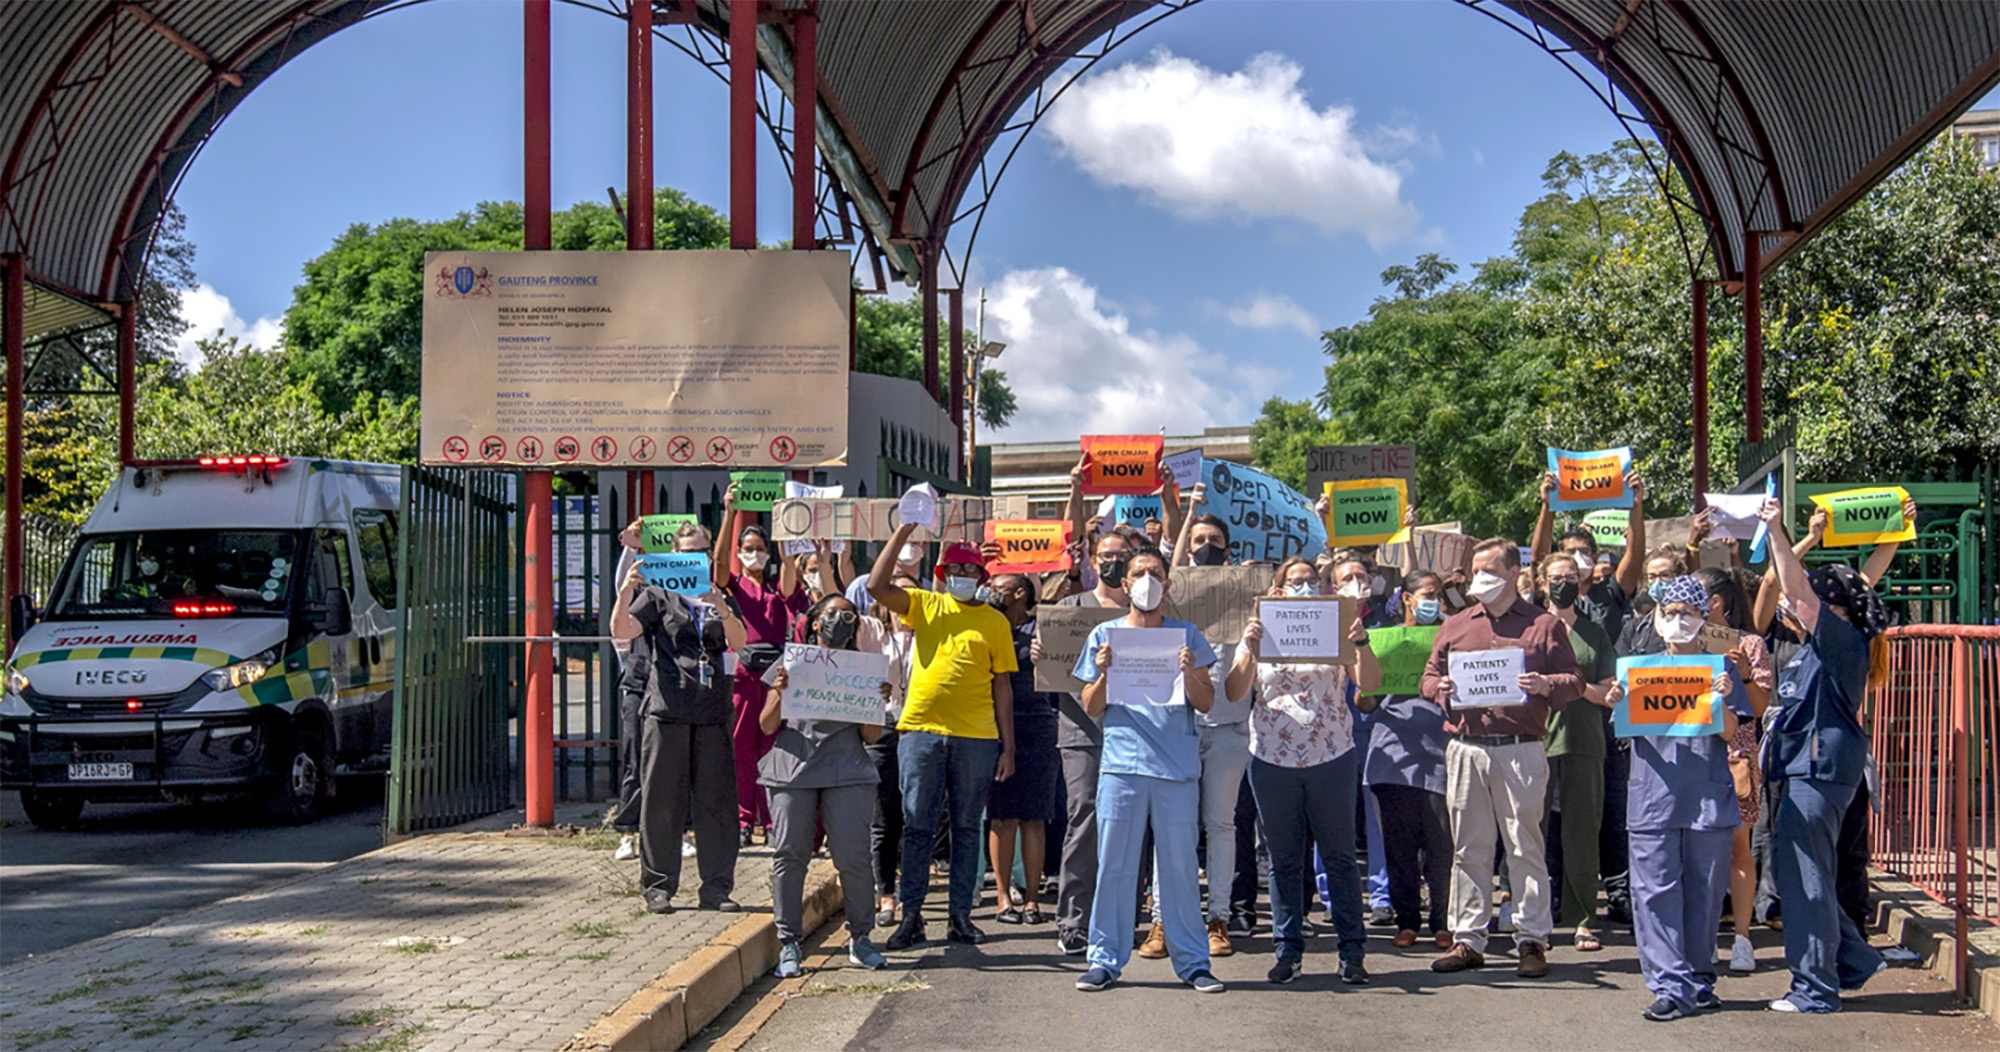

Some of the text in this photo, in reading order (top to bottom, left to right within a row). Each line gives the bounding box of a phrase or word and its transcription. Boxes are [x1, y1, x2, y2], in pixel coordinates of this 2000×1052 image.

[497, 275, 600, 287] GAUTENG PROVINCE
[496, 408, 528, 416] ACTION
[528, 408, 568, 416] CONTROL
[568, 408, 581, 416] OF
[629, 408, 642, 416] TO
[642, 408, 672, 416] PUBLIC
[672, 408, 712, 416] PREMISES
[713, 408, 733, 416] AND
[733, 408, 772, 416] VEHICLES
[1181, 457, 1197, 467] BAD
[1352, 452, 1368, 465] the
[1371, 448, 1411, 473] FIRE
[1102, 464, 1144, 476] NOW
[1563, 464, 1584, 472] OPEN
[1212, 463, 1271, 500] Open
[1570, 475, 1612, 490] NOW
[740, 490, 777, 501] NOW
[1339, 494, 1392, 505] OPEN CMJAH
[1121, 506, 1159, 519] NOW
[1345, 510, 1389, 526] NOW
[1845, 506, 1890, 521] NOW
[782, 501, 874, 537] OPEN
[1229, 499, 1309, 548] Joburg
[1590, 525, 1627, 537] NOW
[651, 532, 673, 546] NO
[1006, 538, 1050, 552] NOW
[1229, 540, 1255, 560] en
[643, 561, 701, 570] OPEN CMJAH
[651, 576, 697, 590] NOW
[1275, 610, 1323, 620] PATIENTS'
[1286, 624, 1312, 633] LIVES
[1710, 629, 1730, 640] CRY
[1279, 637, 1319, 647] MATTER
[786, 646, 838, 669] SPEAK
[1463, 658, 1509, 670] PATIENTS'
[75, 669, 148, 686] IVECO
[1474, 672, 1500, 682] LIVES
[1635, 676, 1705, 685] OPEN CMJAH
[1468, 685, 1507, 696] MATTER
[1643, 694, 1699, 711] NOW
[69, 764, 132, 778] JP16RJ GP
